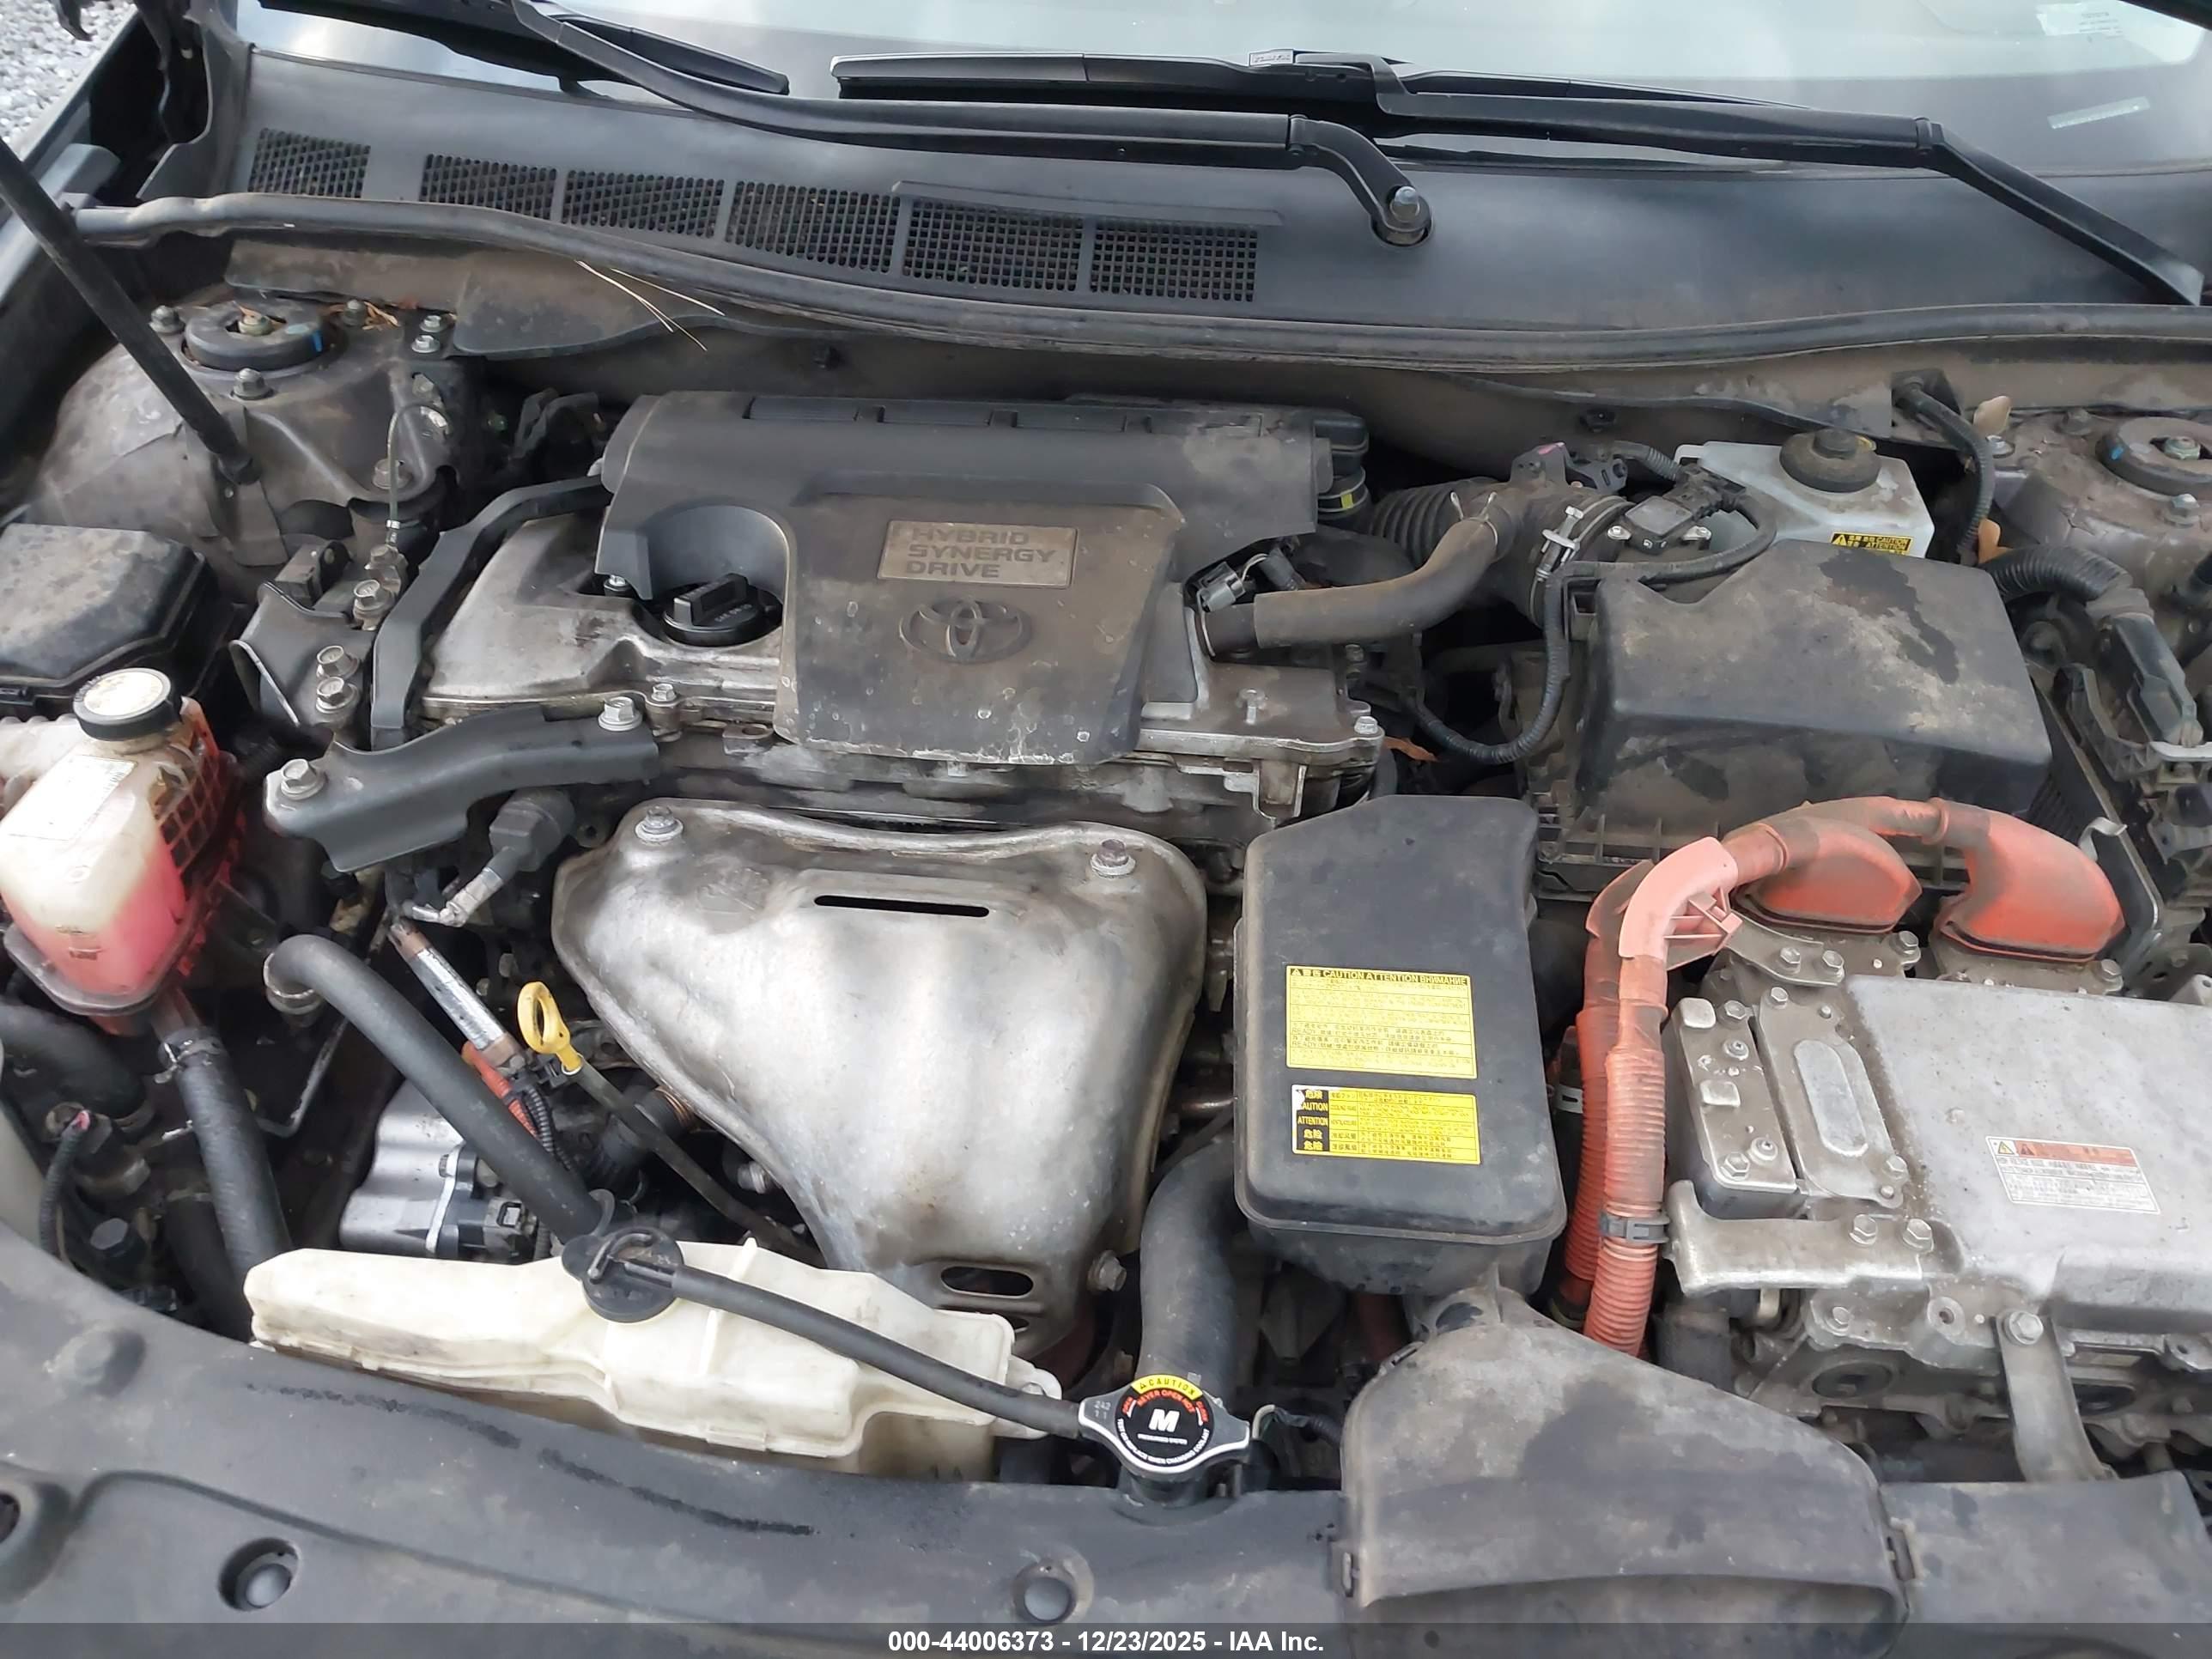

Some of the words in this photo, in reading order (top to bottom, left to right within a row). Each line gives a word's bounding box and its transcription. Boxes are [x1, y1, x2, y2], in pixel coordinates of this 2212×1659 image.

[912, 527, 1030, 545] HYBRID
[1876, 537, 1908, 545] CAUTION
[908, 544, 1056, 562] SYNERGY
[906, 561, 1001, 578] DRIVE
[1322, 969, 1365, 980] CAUTION
[1365, 970, 1418, 983] ATTENTION
[1419, 975, 1468, 987] ВНИМАНИЕ
[1300, 1102, 1328, 1112] AUTION
[1297, 1116, 1328, 1127] ATTENTION
[1149, 1378, 1195, 1396] CAUTION
[1148, 1408, 1181, 1432] M
